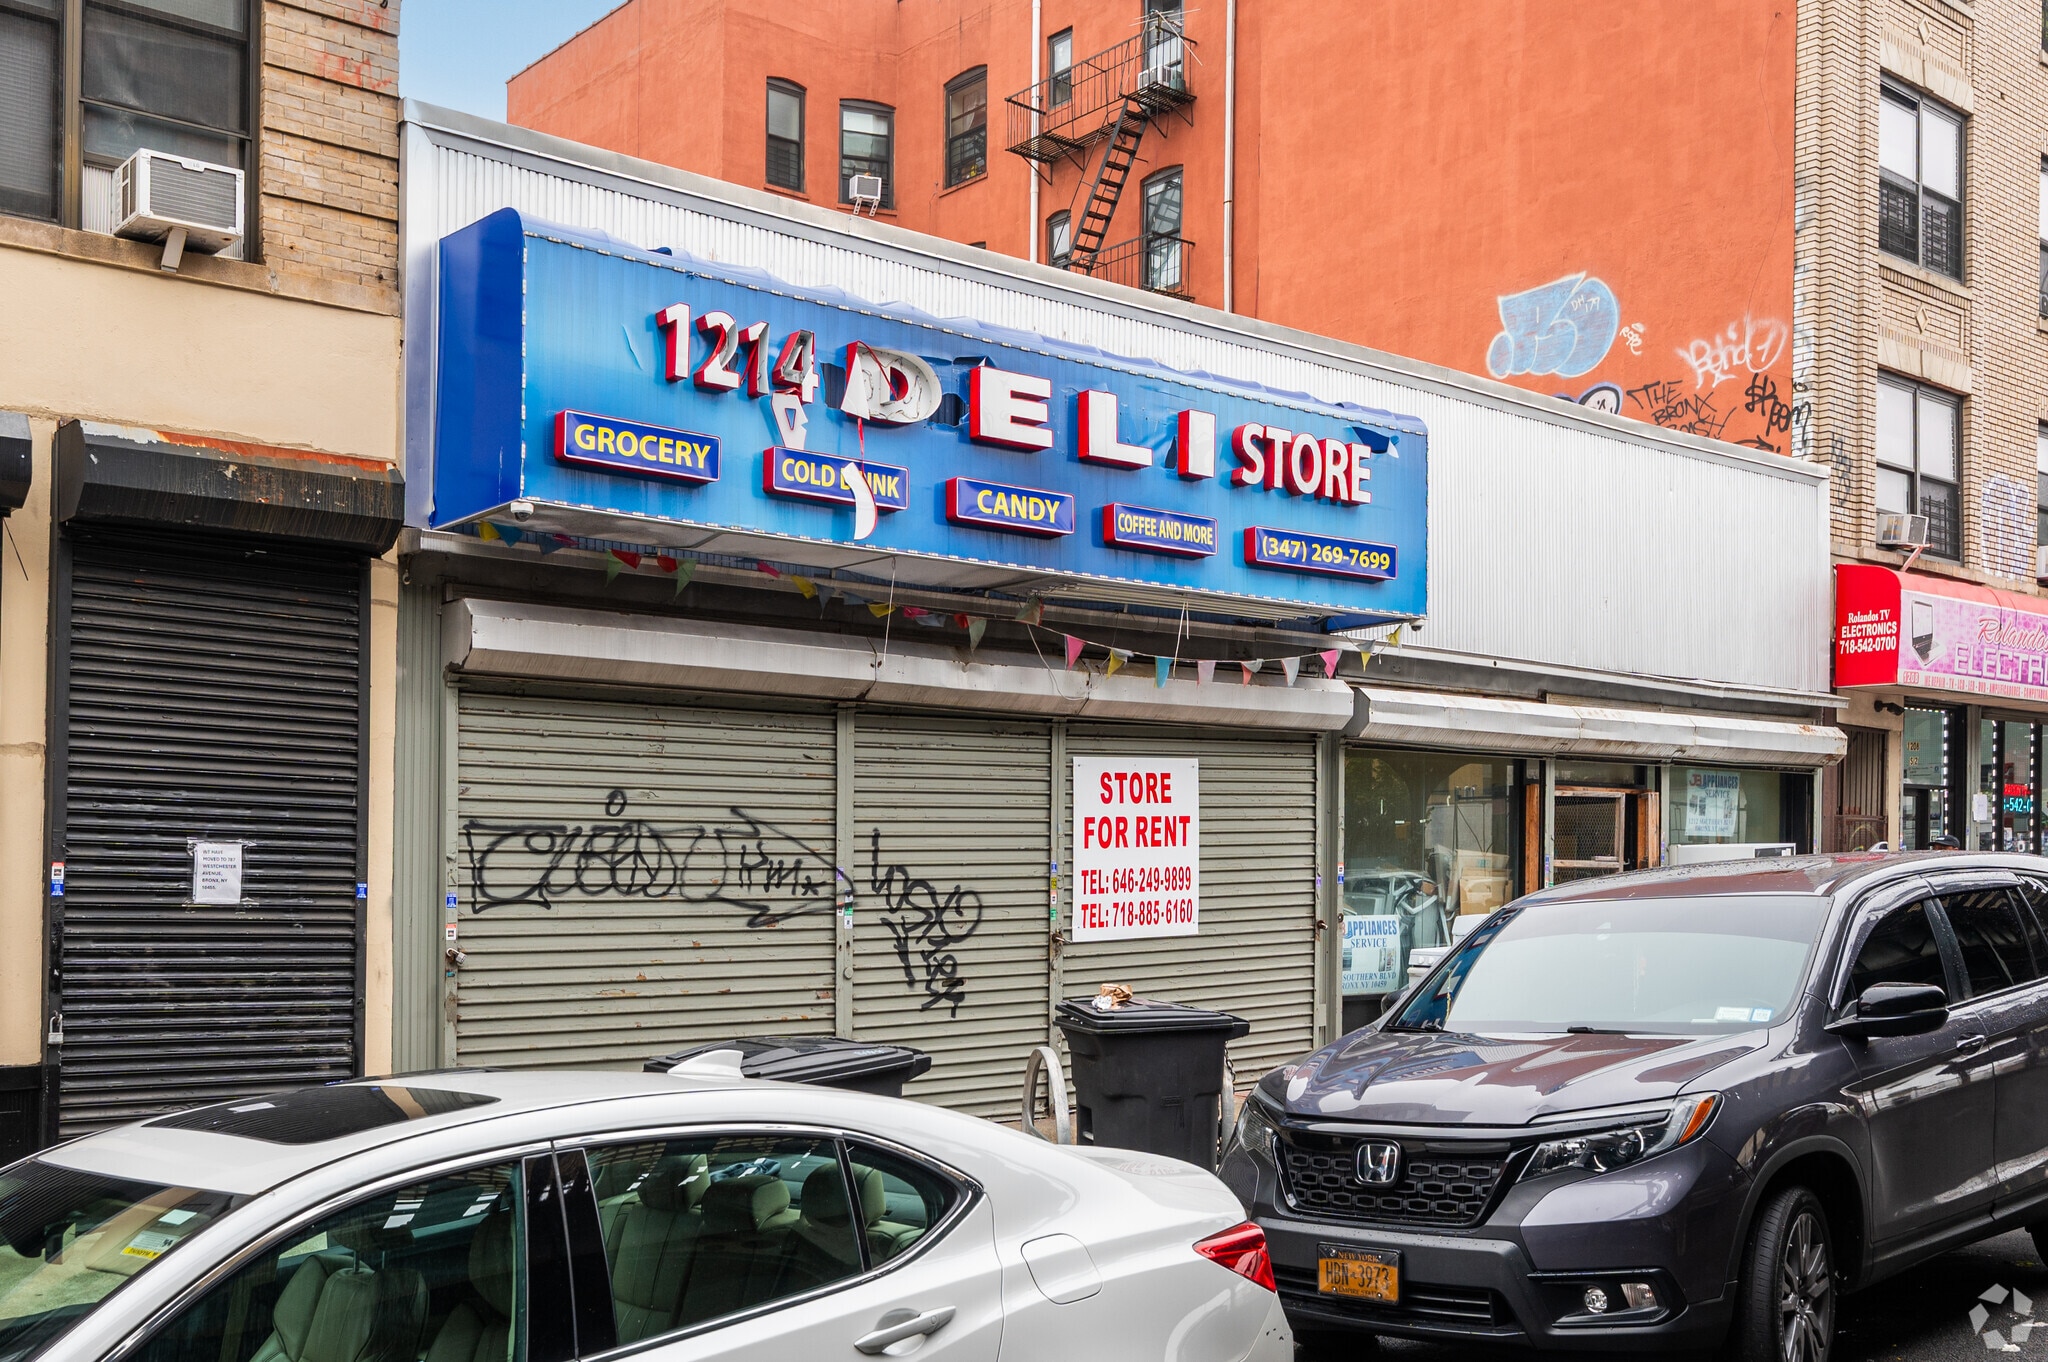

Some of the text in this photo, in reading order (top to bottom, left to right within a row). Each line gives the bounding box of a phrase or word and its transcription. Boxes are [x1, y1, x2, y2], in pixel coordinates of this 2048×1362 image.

[656, 302, 1372, 504] 1214 DELI STORE
[1626, 380, 1683, 410] THE
[1651, 392, 1717, 426] BRONX
[574, 423, 711, 469] GROCERY
[782, 458, 836, 488] COLD
[977, 489, 1060, 524] CANDY
[1118, 513, 1213, 546] COFFEE AND MORE
[1262, 536, 1391, 571] (347) 269-7699
[1841, 621, 1897, 639] ELECTRONICS
[1848, 608, 1891, 624] Rolandos TV
[1839, 636, 1897, 655] 718-542-0700
[1100, 772, 1172, 804] STORE
[1702, 774, 1739, 789] APPLIANCES
[1704, 789, 1731, 799] SERVICE
[1084, 815, 1191, 849] FOR RENT
[1081, 869, 1109, 895] TEL:
[1112, 866, 1191, 894] 646-249-9899
[1081, 898, 1193, 928] TEL: 718-885-6160
[1347, 920, 1397, 938] APPLIANCES
[1350, 938, 1388, 948] SERVICE
[1342, 981, 1359, 990] RONX
[1360, 980, 1370, 989] NY
[1343, 971, 1397, 981] SOUTHERN BLVD
[1337, 1251, 1379, 1263] NEW YORK
